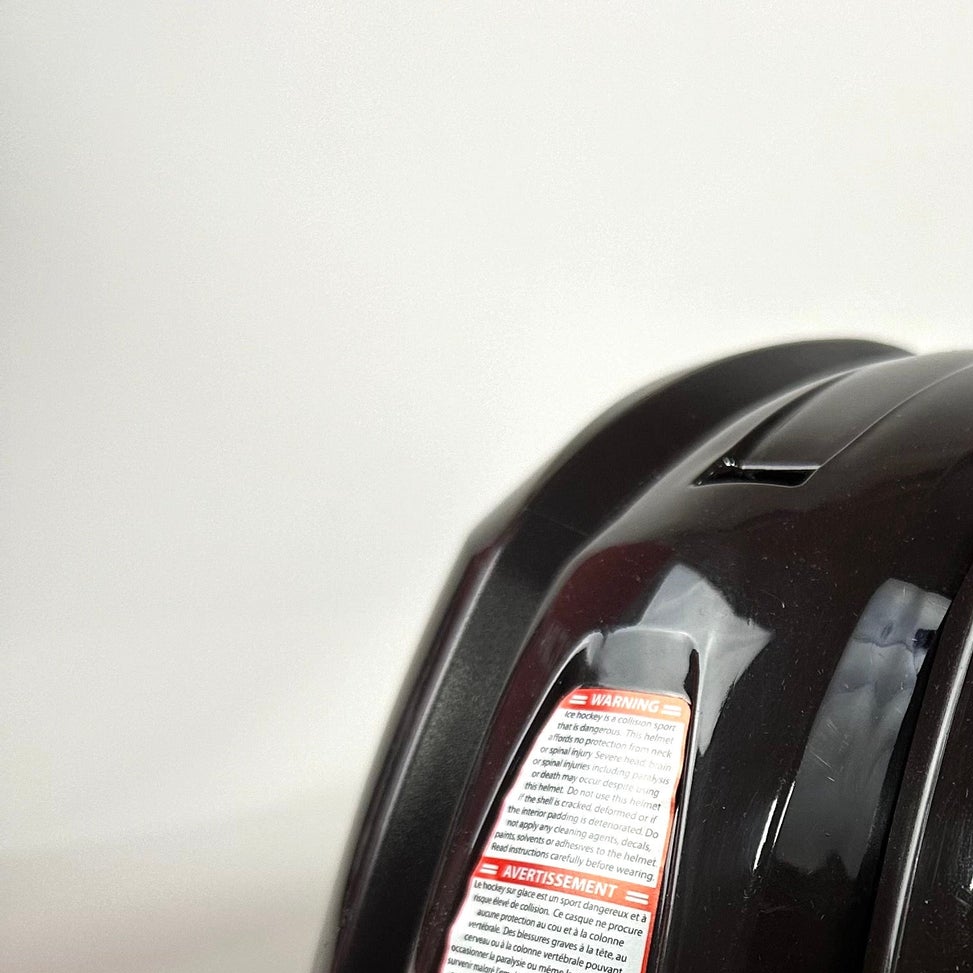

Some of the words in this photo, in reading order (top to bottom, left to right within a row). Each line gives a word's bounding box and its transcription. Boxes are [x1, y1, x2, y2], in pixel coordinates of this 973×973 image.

[590, 694, 660, 713] WARNING
[502, 865, 618, 898] AVERTISSEMENT
[482, 881, 506, 894] hockey
[516, 888, 536, 898] glace
[536, 892, 548, 900] est
[560, 897, 581, 908] sport
[582, 901, 628, 918] dangereux
[546, 923, 562, 932] cou
[588, 932, 624, 946] colonne
[564, 913, 594, 925] casque
[606, 922, 643, 936] procure
[502, 926, 516, 936] Des
[516, 929, 550, 944] blessures
[550, 938, 578, 950] graves
[595, 948, 614, 960] tête,
[495, 954, 526, 967] paralysie
[512, 944, 542, 957] colonne
[542, 951, 585, 968] vertébrale
